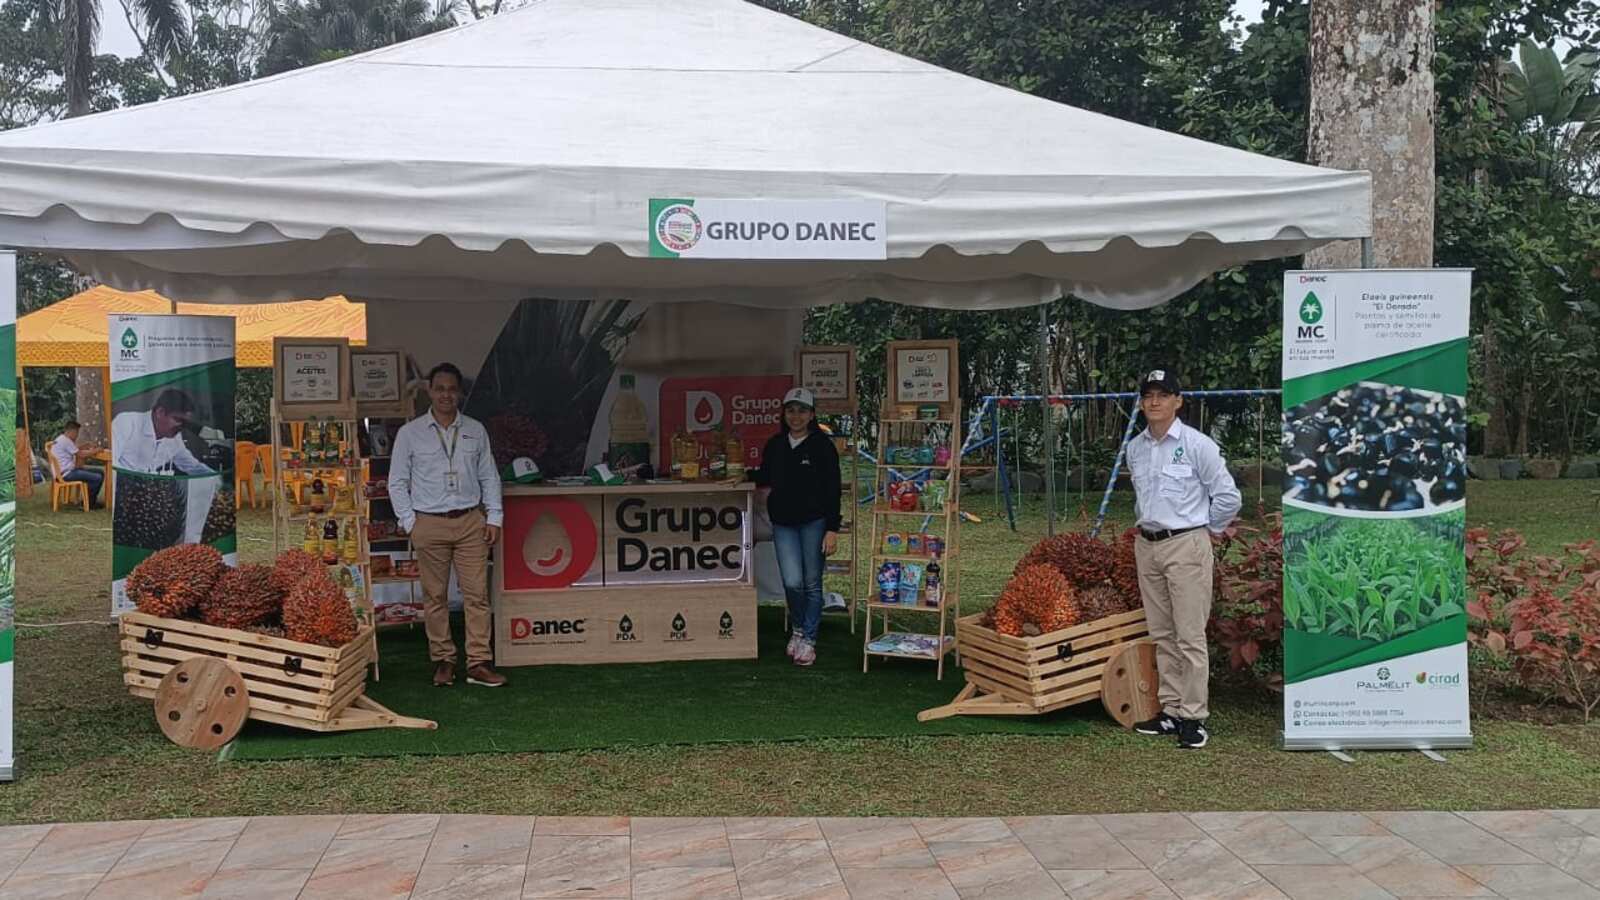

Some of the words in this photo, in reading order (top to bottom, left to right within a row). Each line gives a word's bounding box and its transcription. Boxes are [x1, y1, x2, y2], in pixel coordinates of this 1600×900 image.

[706, 221, 790, 241] GRUPO
[795, 221, 877, 241] DANEC
[1297, 325, 1325, 339] MC
[120, 349, 139, 358] MC
[731, 395, 781, 413] Grupo
[731, 411, 781, 425] Danec
[615, 498, 742, 541] Grupo
[617, 537, 741, 572] Danec
[511, 617, 585, 640] Danec
